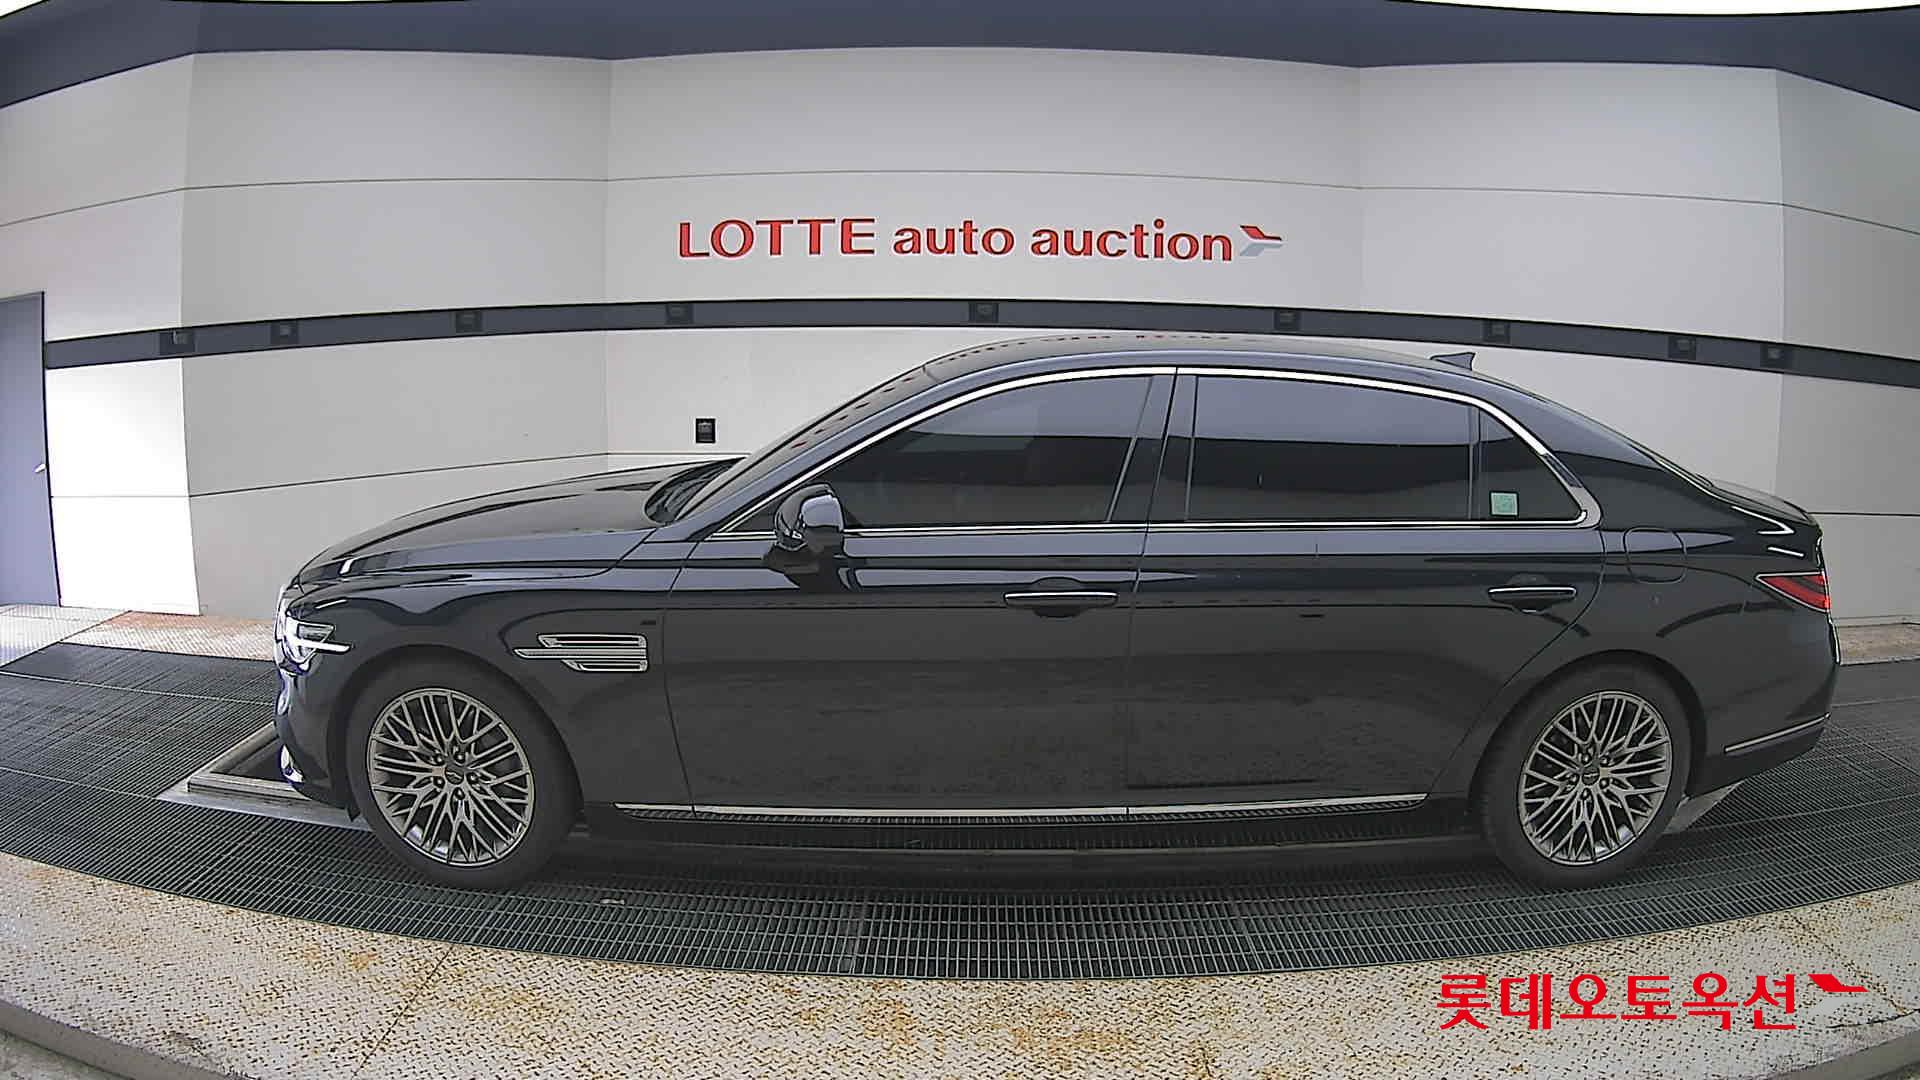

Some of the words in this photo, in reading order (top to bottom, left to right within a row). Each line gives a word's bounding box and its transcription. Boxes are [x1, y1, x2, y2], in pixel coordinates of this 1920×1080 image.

[678, 218, 876, 258] LOTTE
[893, 219, 1015, 257] auto
[1030, 219, 1233, 262] auction
